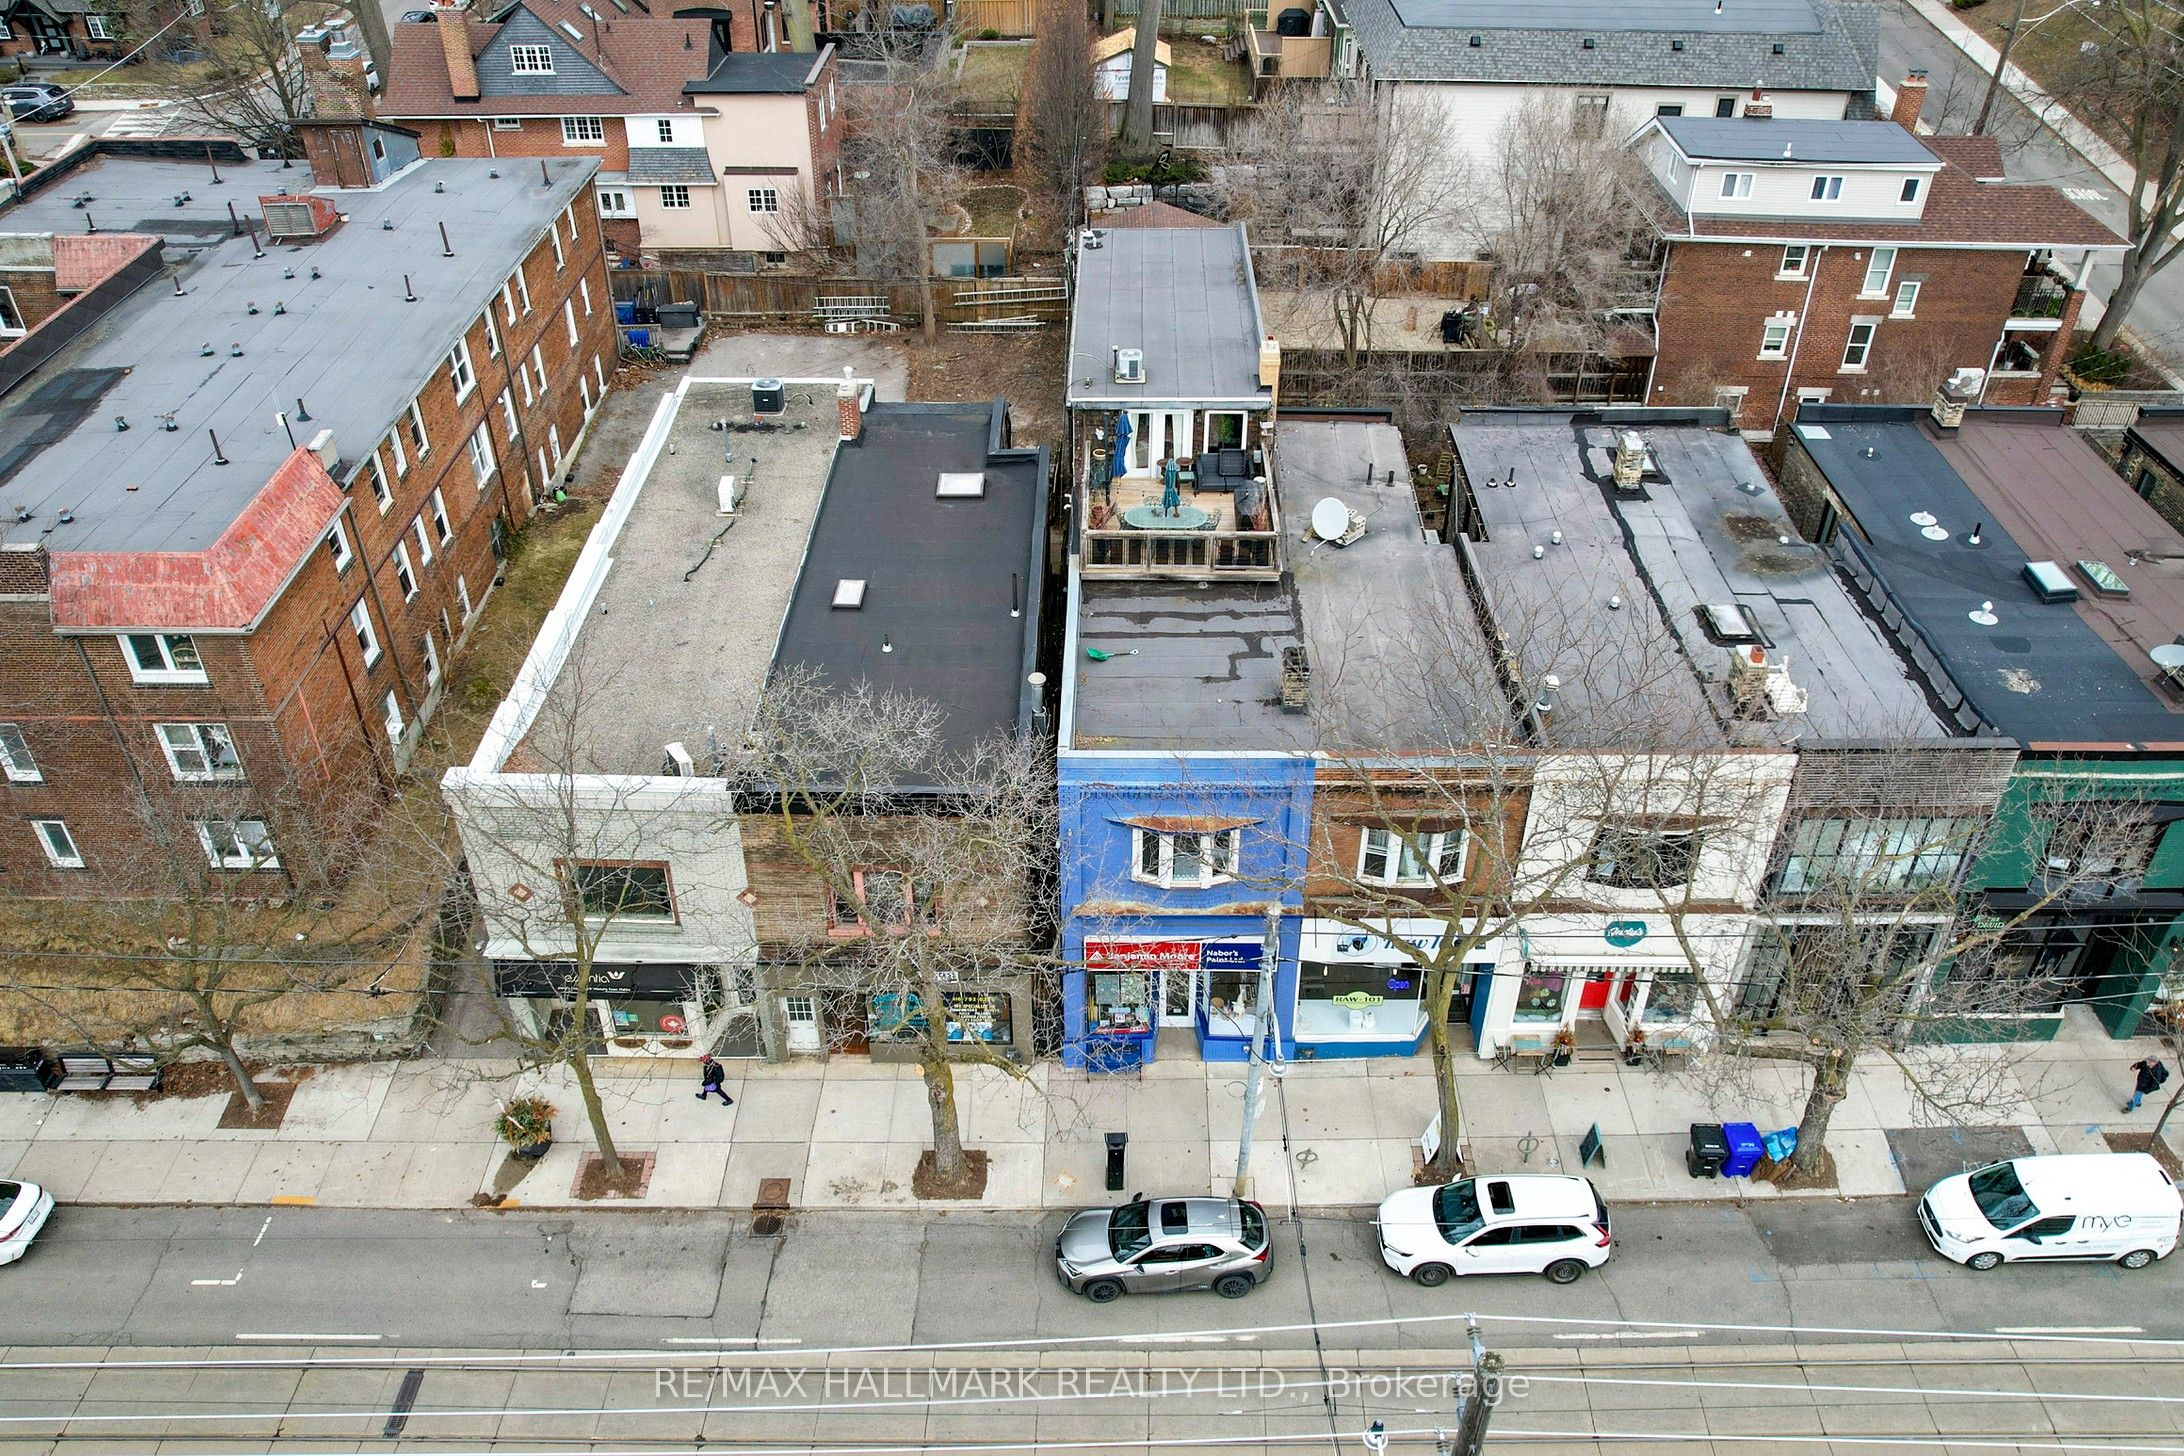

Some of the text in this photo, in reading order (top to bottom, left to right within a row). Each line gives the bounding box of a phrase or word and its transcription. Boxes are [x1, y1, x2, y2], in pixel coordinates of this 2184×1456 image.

[1107, 952, 1195, 962] Benjamin Moore
[1206, 949, 1239, 957] Nabor's
[1388, 979, 1409, 991] Open
